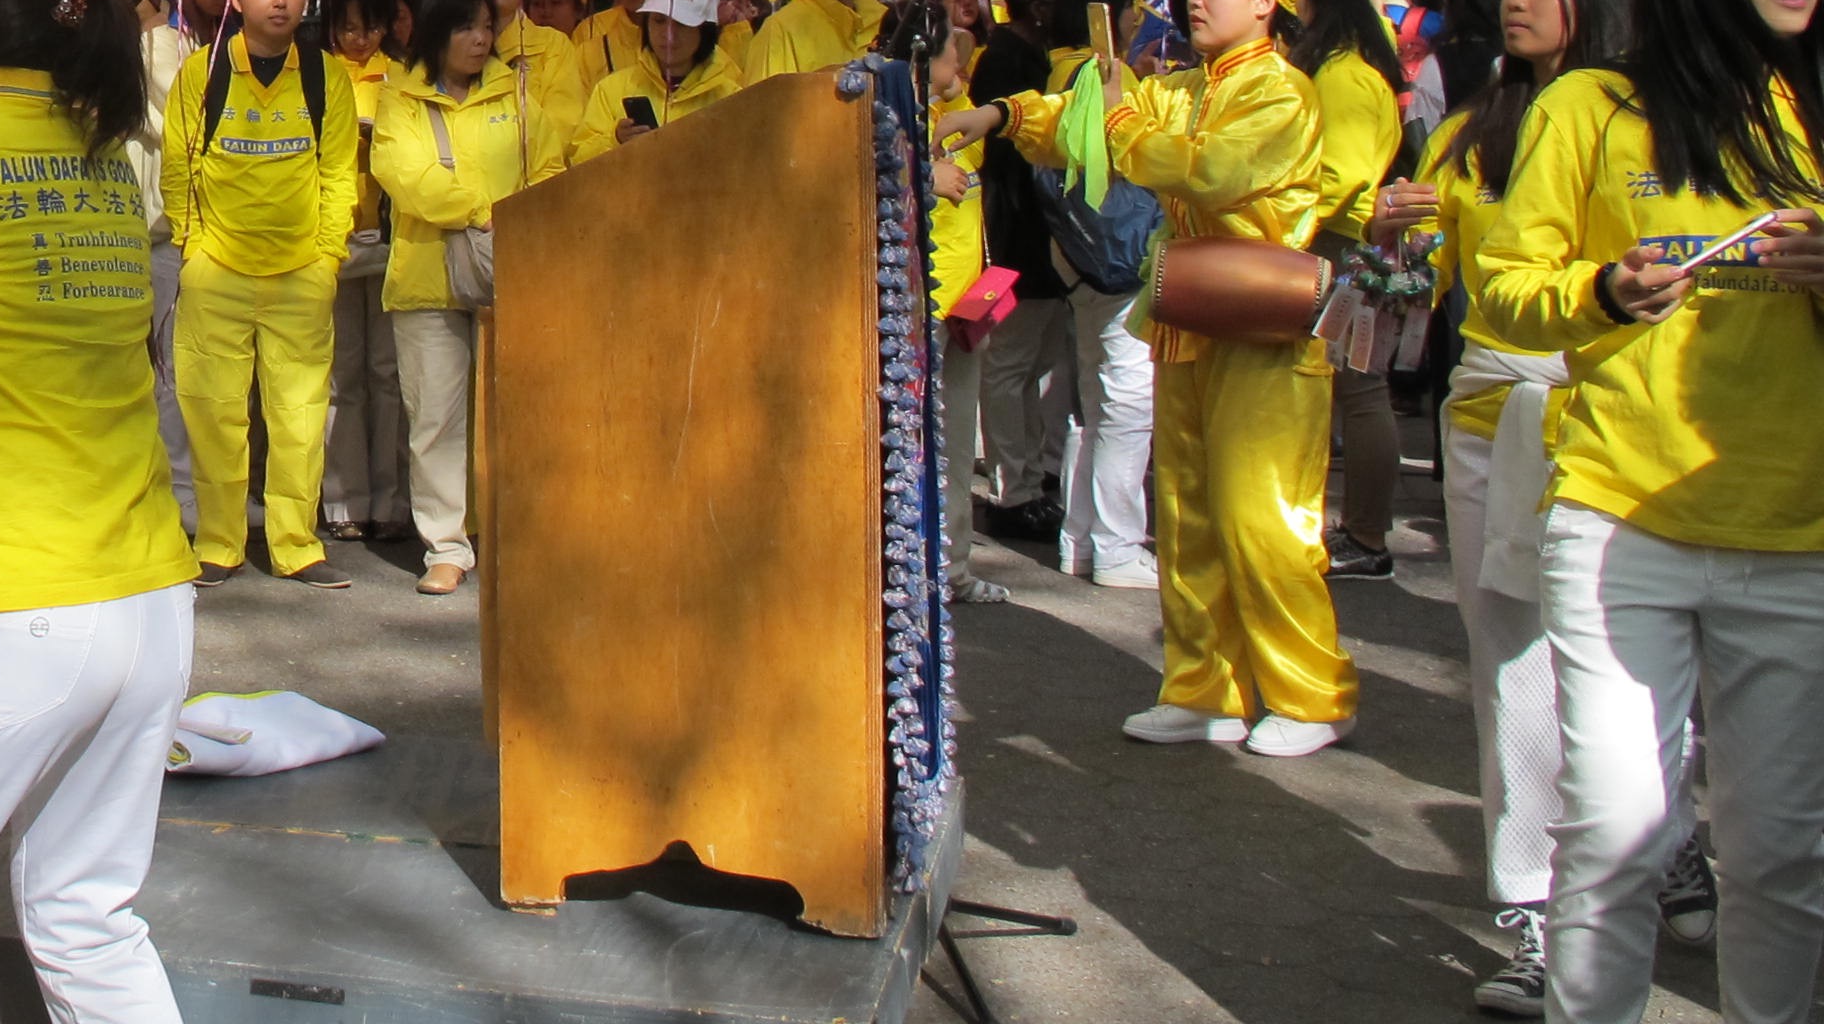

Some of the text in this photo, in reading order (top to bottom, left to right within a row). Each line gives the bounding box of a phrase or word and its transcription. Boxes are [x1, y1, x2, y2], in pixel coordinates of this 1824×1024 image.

[223, 139, 308, 153] FALUN DAFA
[55, 230, 144, 251] Truthfulness
[61, 255, 144, 276] Benevolence
[63, 281, 145, 301] Forbearance
